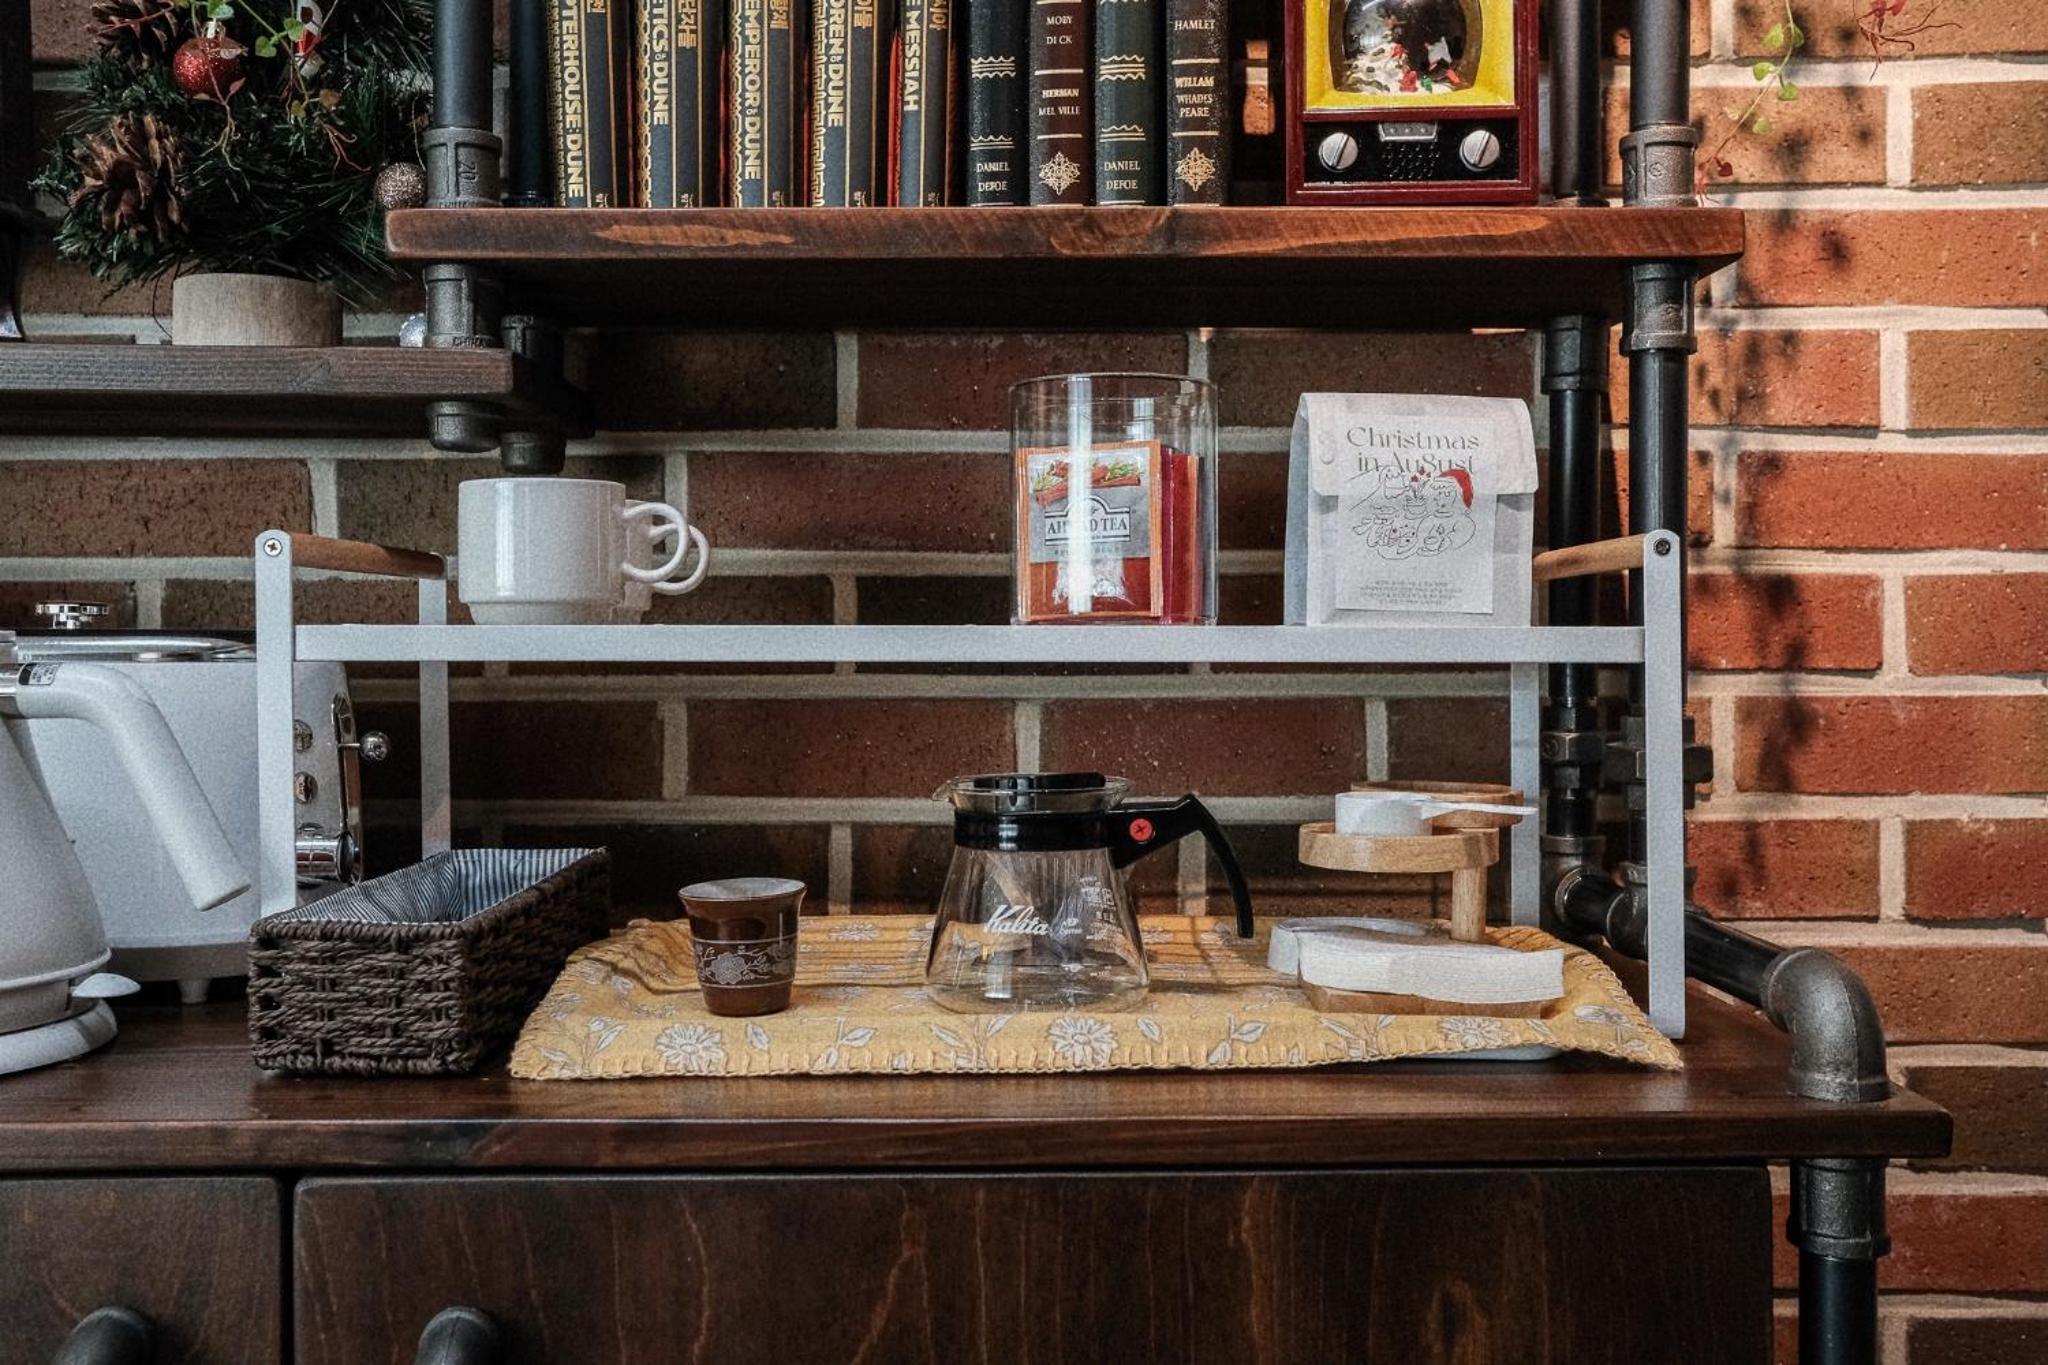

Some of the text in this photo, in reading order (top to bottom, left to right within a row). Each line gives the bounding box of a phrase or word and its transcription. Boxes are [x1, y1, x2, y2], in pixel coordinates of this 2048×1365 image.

[1046, 15, 1073, 25] MOBY
[1174, 19, 1216, 31] HAMLET
[744, 0, 761, 108] EMPEROR
[903, 10, 922, 111] MESSIAH
[653, 62, 669, 125] DUNE
[827, 63, 845, 127] DUNE
[744, 117, 761, 180] DUNE
[566, 133, 584, 197] DUNE
[976, 162, 1011, 173] DANIEL
[1104, 161, 1141, 171] DANIEL
[1106, 180, 1139, 190] DEFOE
[1347, 426, 1480, 450] Christmas
[1358, 452, 1380, 472] in
[1101, 517, 1128, 532] TEA
[985, 904, 1049, 936] Kalita
